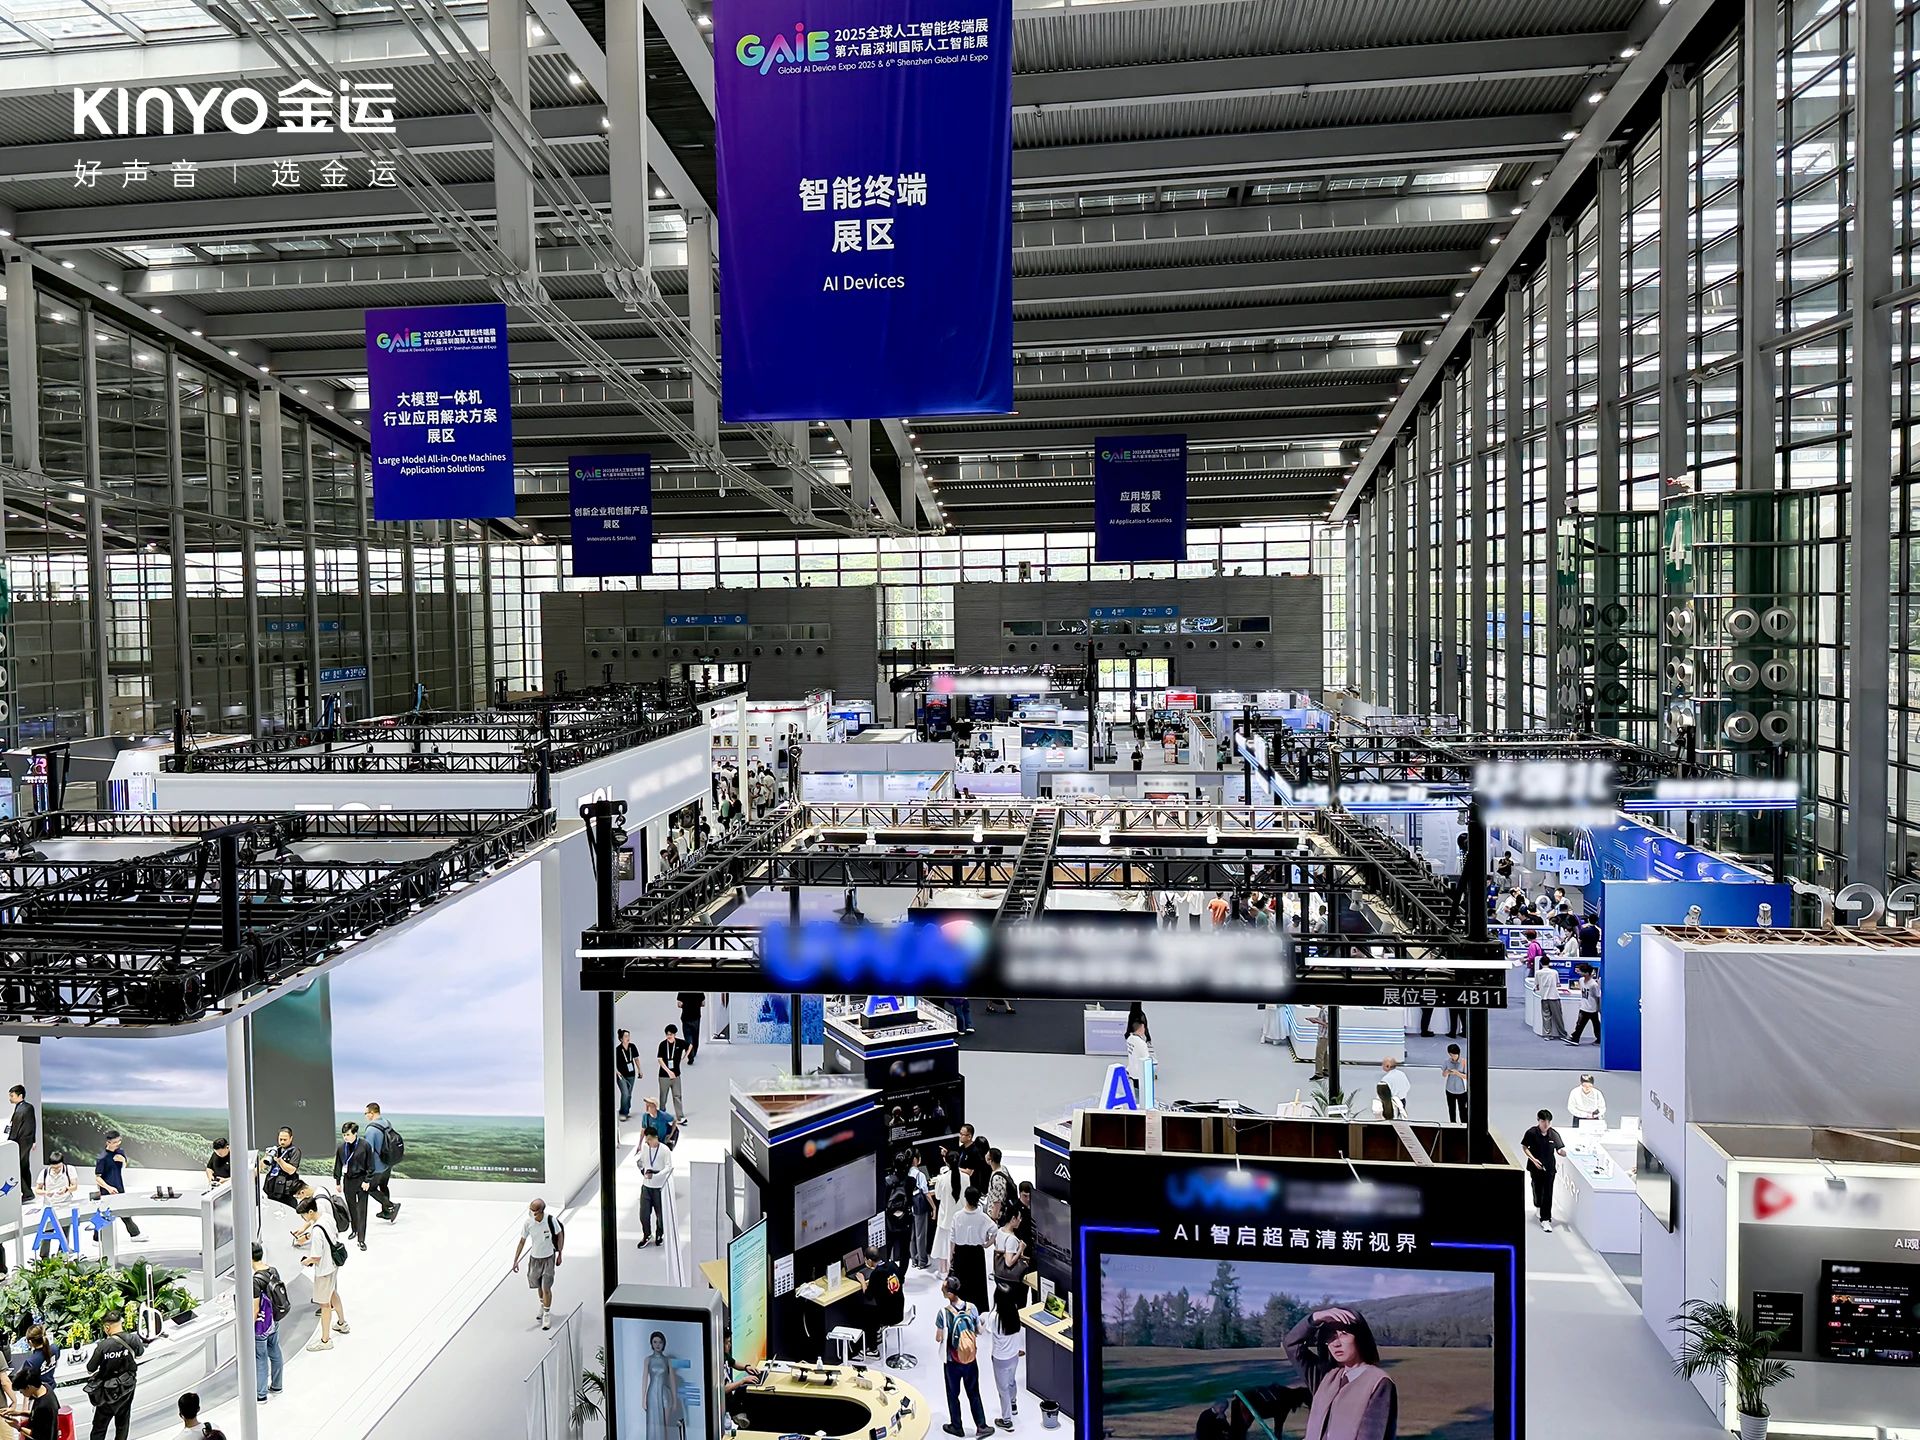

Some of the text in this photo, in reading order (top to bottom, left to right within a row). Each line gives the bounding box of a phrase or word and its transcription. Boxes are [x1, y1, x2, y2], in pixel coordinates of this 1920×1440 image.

[834, 18, 989, 42] 2025全球人工智能终端展
[835, 35, 989, 58] 第六届深圳国际人工智能展
[777, 66, 802, 75] Global
[803, 65, 811, 73] AI
[812, 63, 837, 72] Device
[838, 63, 857, 72] Expo
[858, 61, 876, 69] 2025
[897, 57, 932, 66] Shenzhen
[934, 55, 959, 64] Global
[960, 54, 968, 62] AI
[969, 53, 989, 63] Expo
[798, 172, 928, 211] 智能终端
[831, 218, 896, 253] 展区
[823, 271, 906, 291] AI Devices
[397, 389, 483, 407] 大模型一体机
[383, 408, 498, 426] 行业应用解决方案
[427, 428, 456, 443] 展区
[378, 453, 507, 466] Large Model All-in-One Machines
[400, 464, 485, 476] Application Solutions
[1120, 490, 1162, 501] 应用场景
[574, 506, 648, 516] 创新企业和创新产品
[1130, 502, 1151, 513] 展区
[603, 520, 620, 529] 展区
[1669, 519, 1686, 570] 4
[1456, 990, 1501, 1005] 4B11
[32, 1206, 80, 1253] AI
[1173, 1223, 1418, 1253] AI 智启超高清新视界
[104, 1349, 129, 1360] HON
